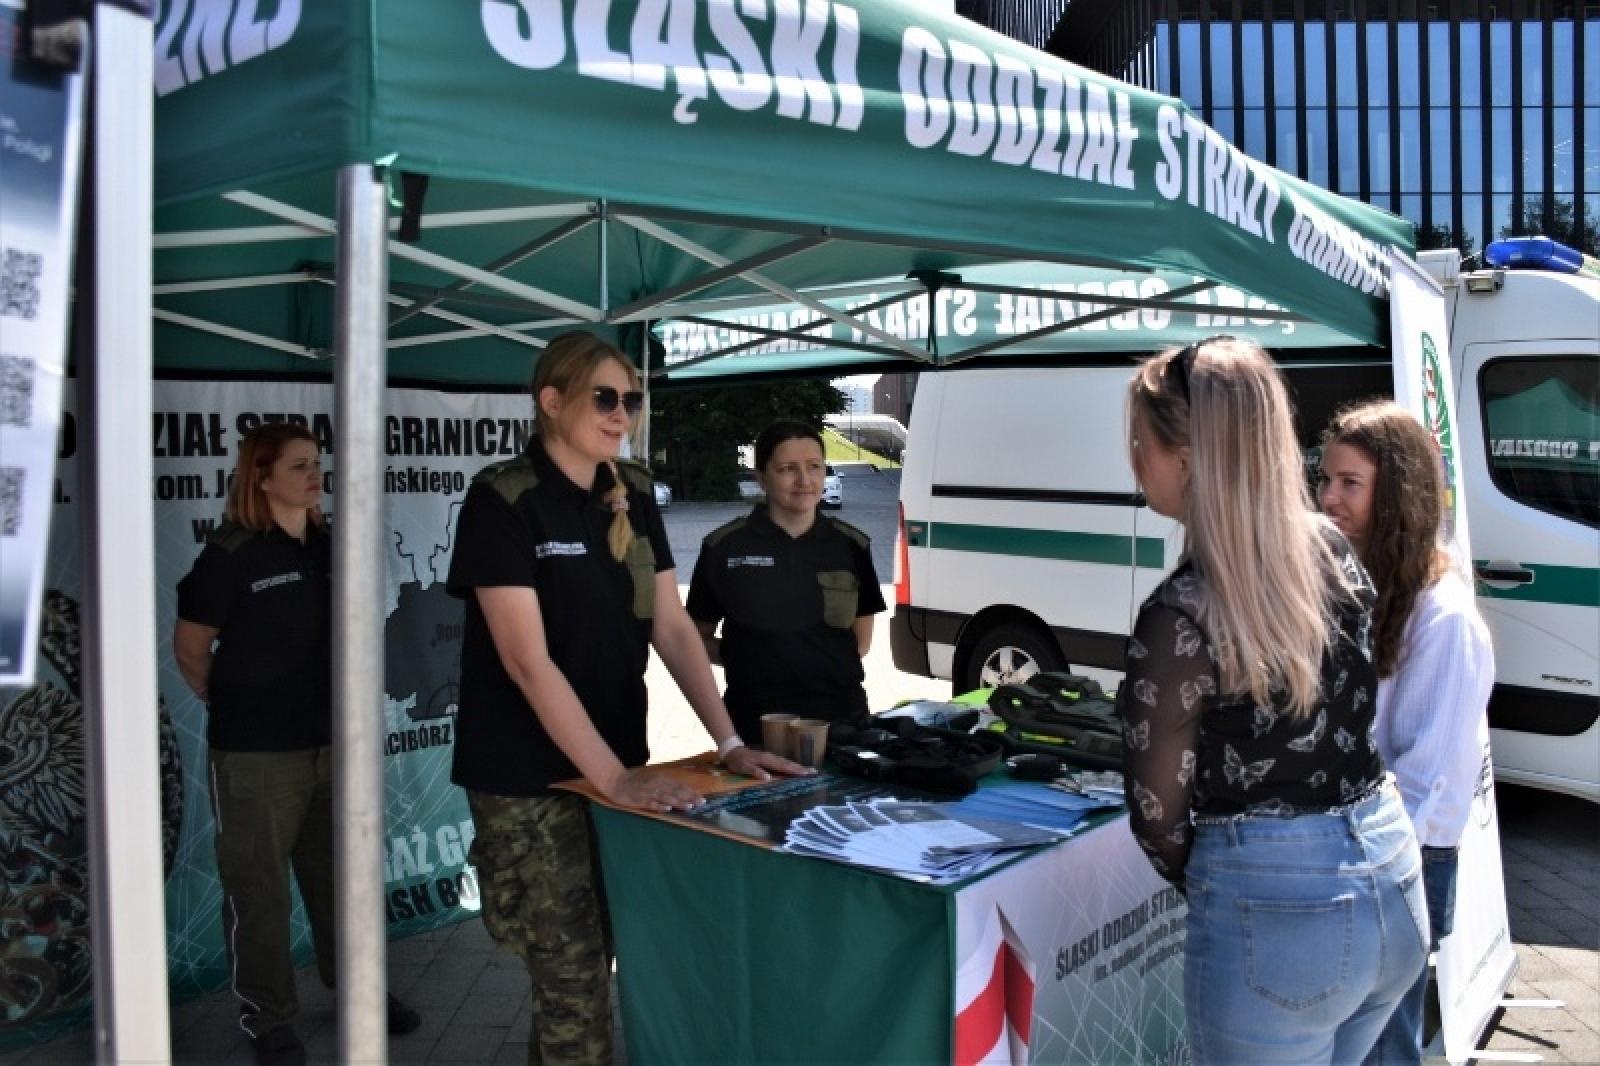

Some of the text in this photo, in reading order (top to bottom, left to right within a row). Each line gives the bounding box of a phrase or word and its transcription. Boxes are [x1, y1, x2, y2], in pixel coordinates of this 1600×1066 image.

[898, 26, 1139, 190] ODDZIAŁ
[153, 411, 229, 458] ZIAŁ
[384, 415, 534, 457] GRANICZN
[384, 465, 465, 496] ńskiego
[384, 723, 453, 757] CIBÓRZ
